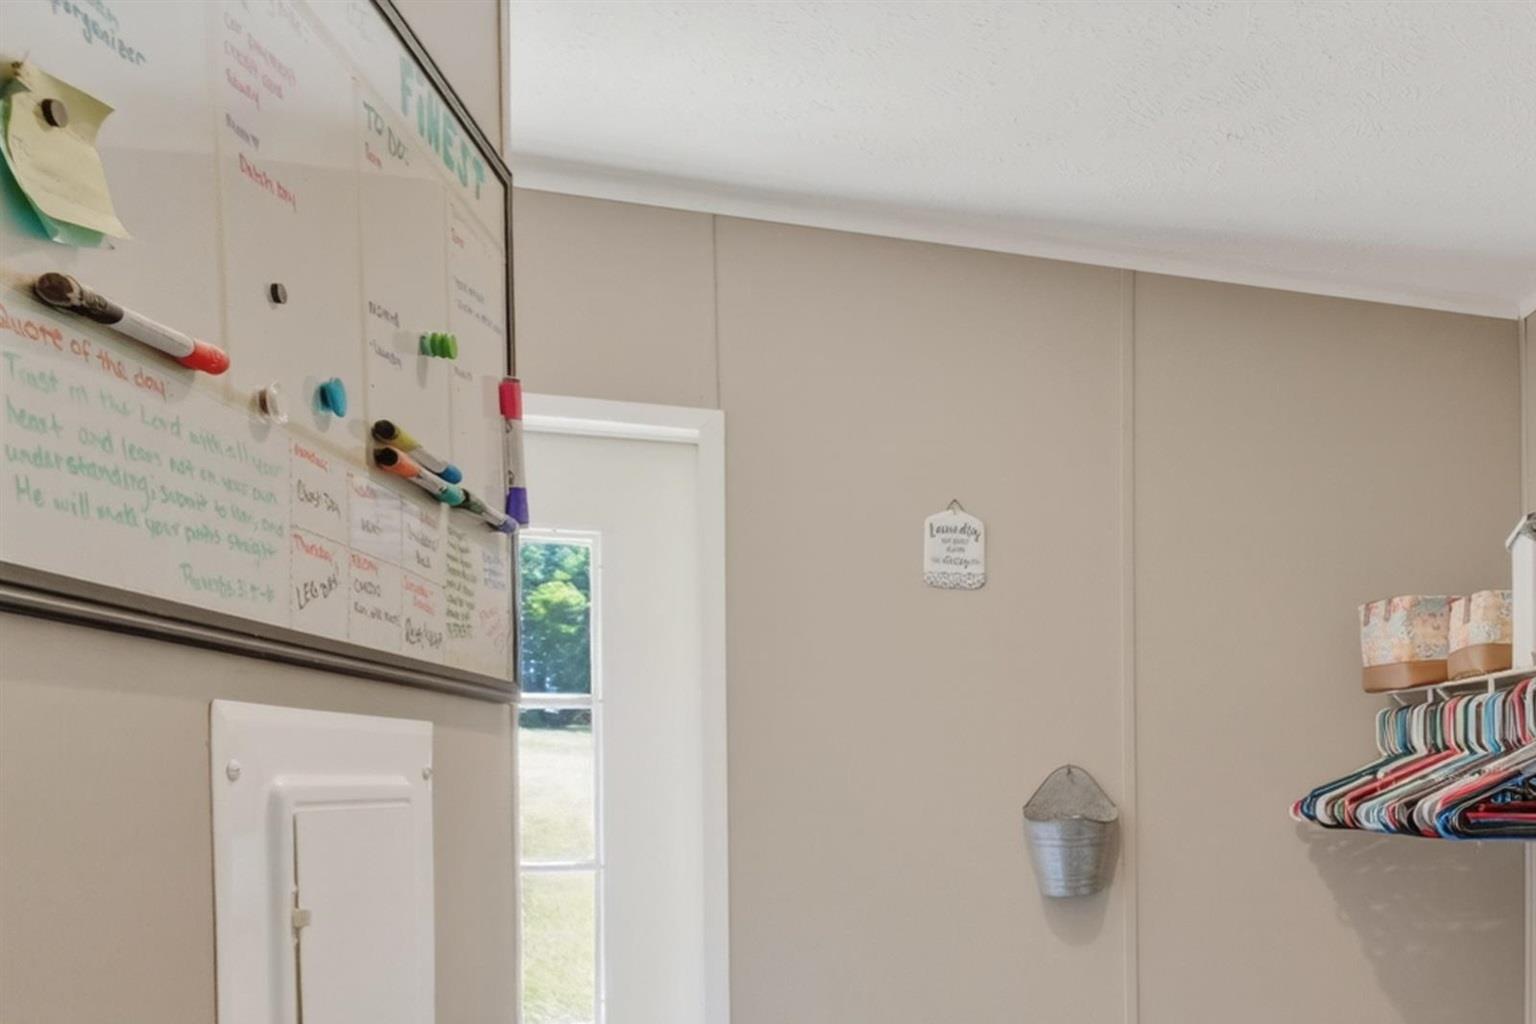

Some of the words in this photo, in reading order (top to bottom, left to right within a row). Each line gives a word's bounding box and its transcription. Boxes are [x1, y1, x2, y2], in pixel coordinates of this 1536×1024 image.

[70, 339, 91, 362] of
[97, 350, 128, 381] the
[2, 352, 59, 394] Trust
[140, 403, 181, 438] Lord
[15, 473, 44, 508] He
[53, 491, 90, 519] will
